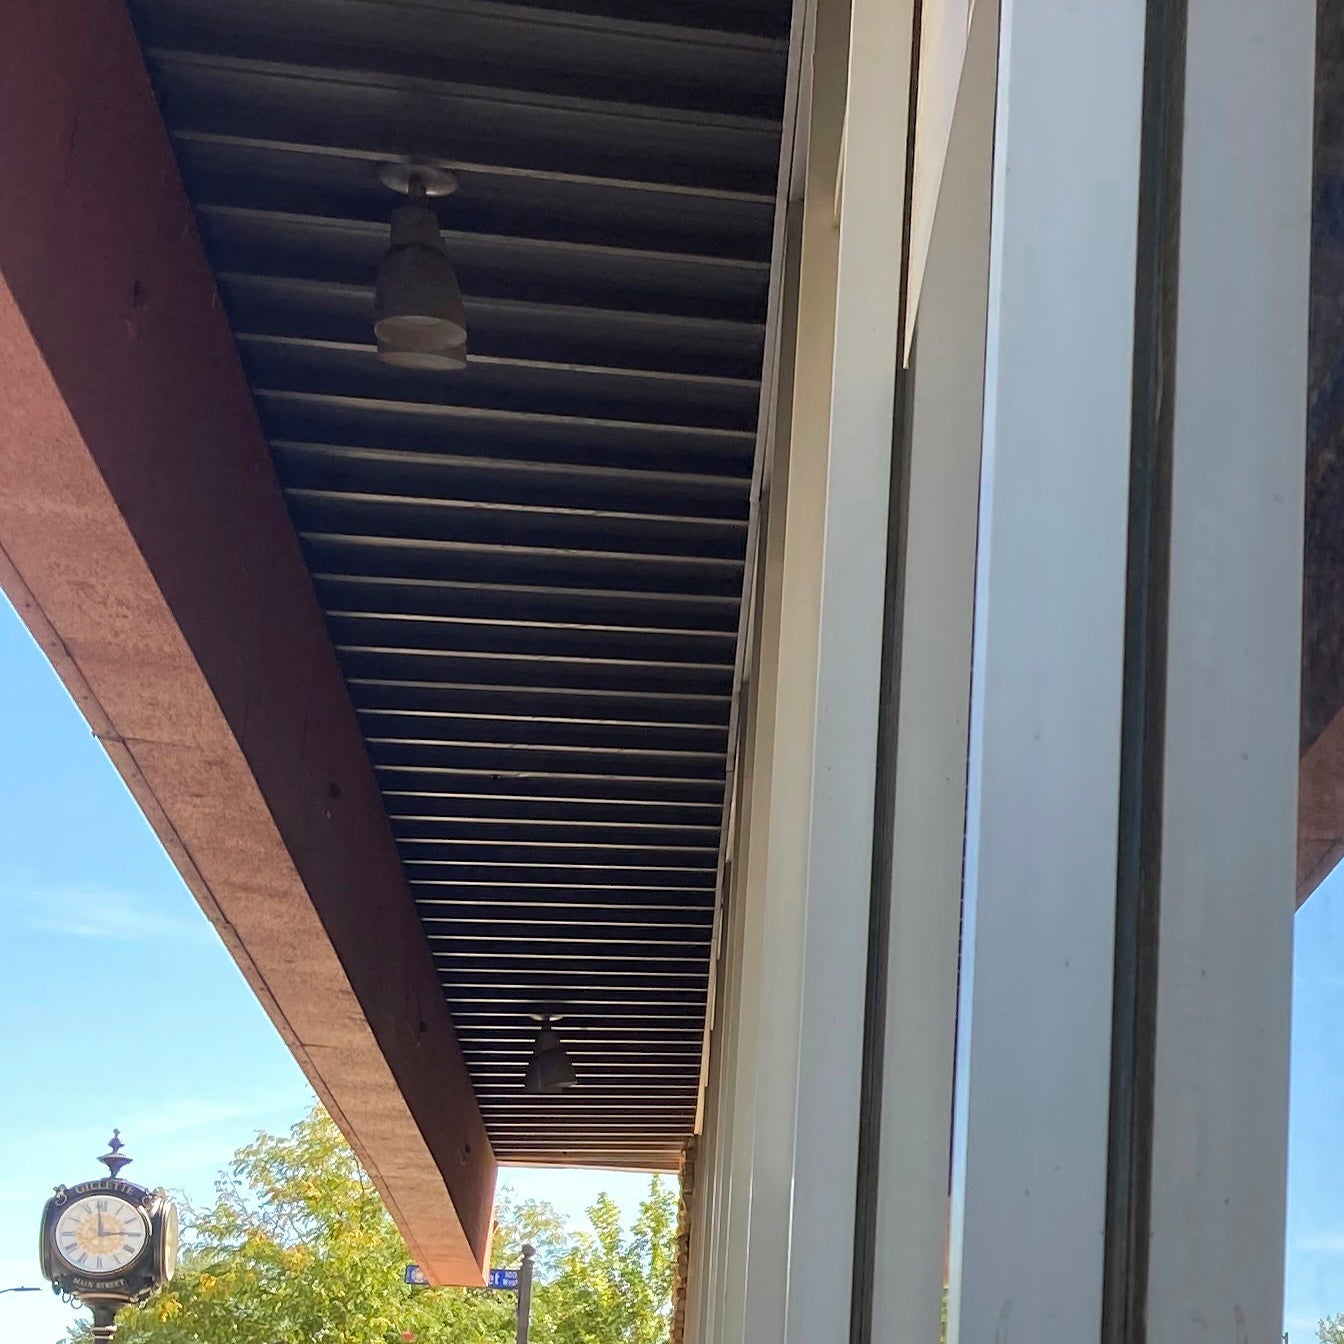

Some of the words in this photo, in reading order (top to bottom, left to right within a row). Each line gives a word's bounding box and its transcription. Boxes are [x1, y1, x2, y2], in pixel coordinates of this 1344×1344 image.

[75, 1180, 135, 1195] GILLETTE
[73, 1278, 92, 1288] MAIN
[96, 1279, 125, 1289] STREET
